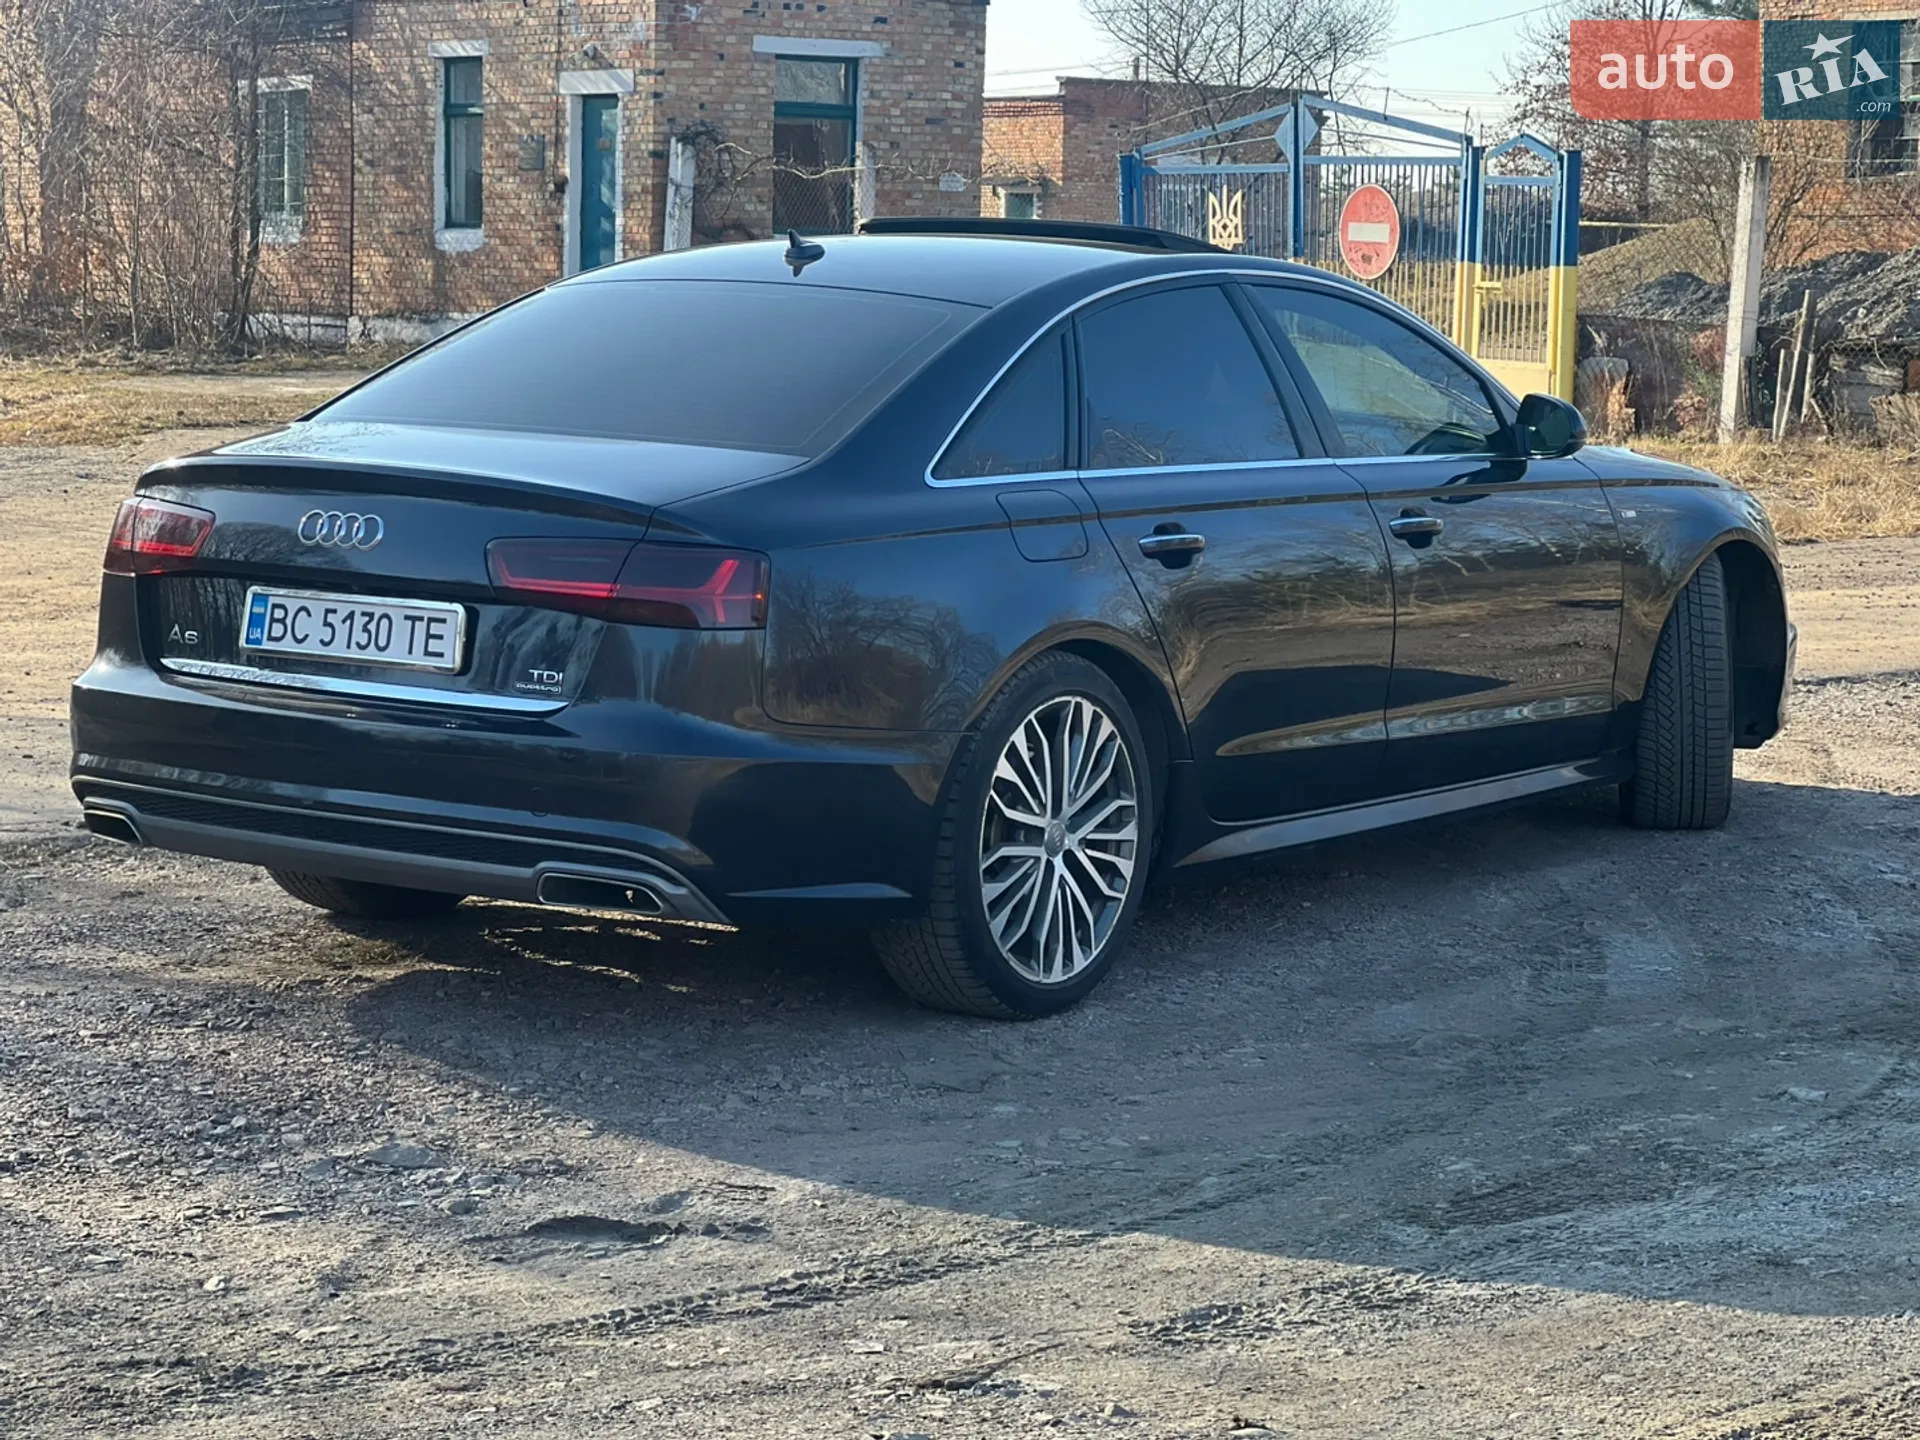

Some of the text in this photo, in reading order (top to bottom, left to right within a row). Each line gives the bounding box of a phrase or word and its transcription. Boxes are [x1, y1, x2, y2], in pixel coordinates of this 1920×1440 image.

[167, 623, 199, 645] A6
[266, 603, 447, 658] BC 5130 TE
[528, 669, 563, 684] TDI
